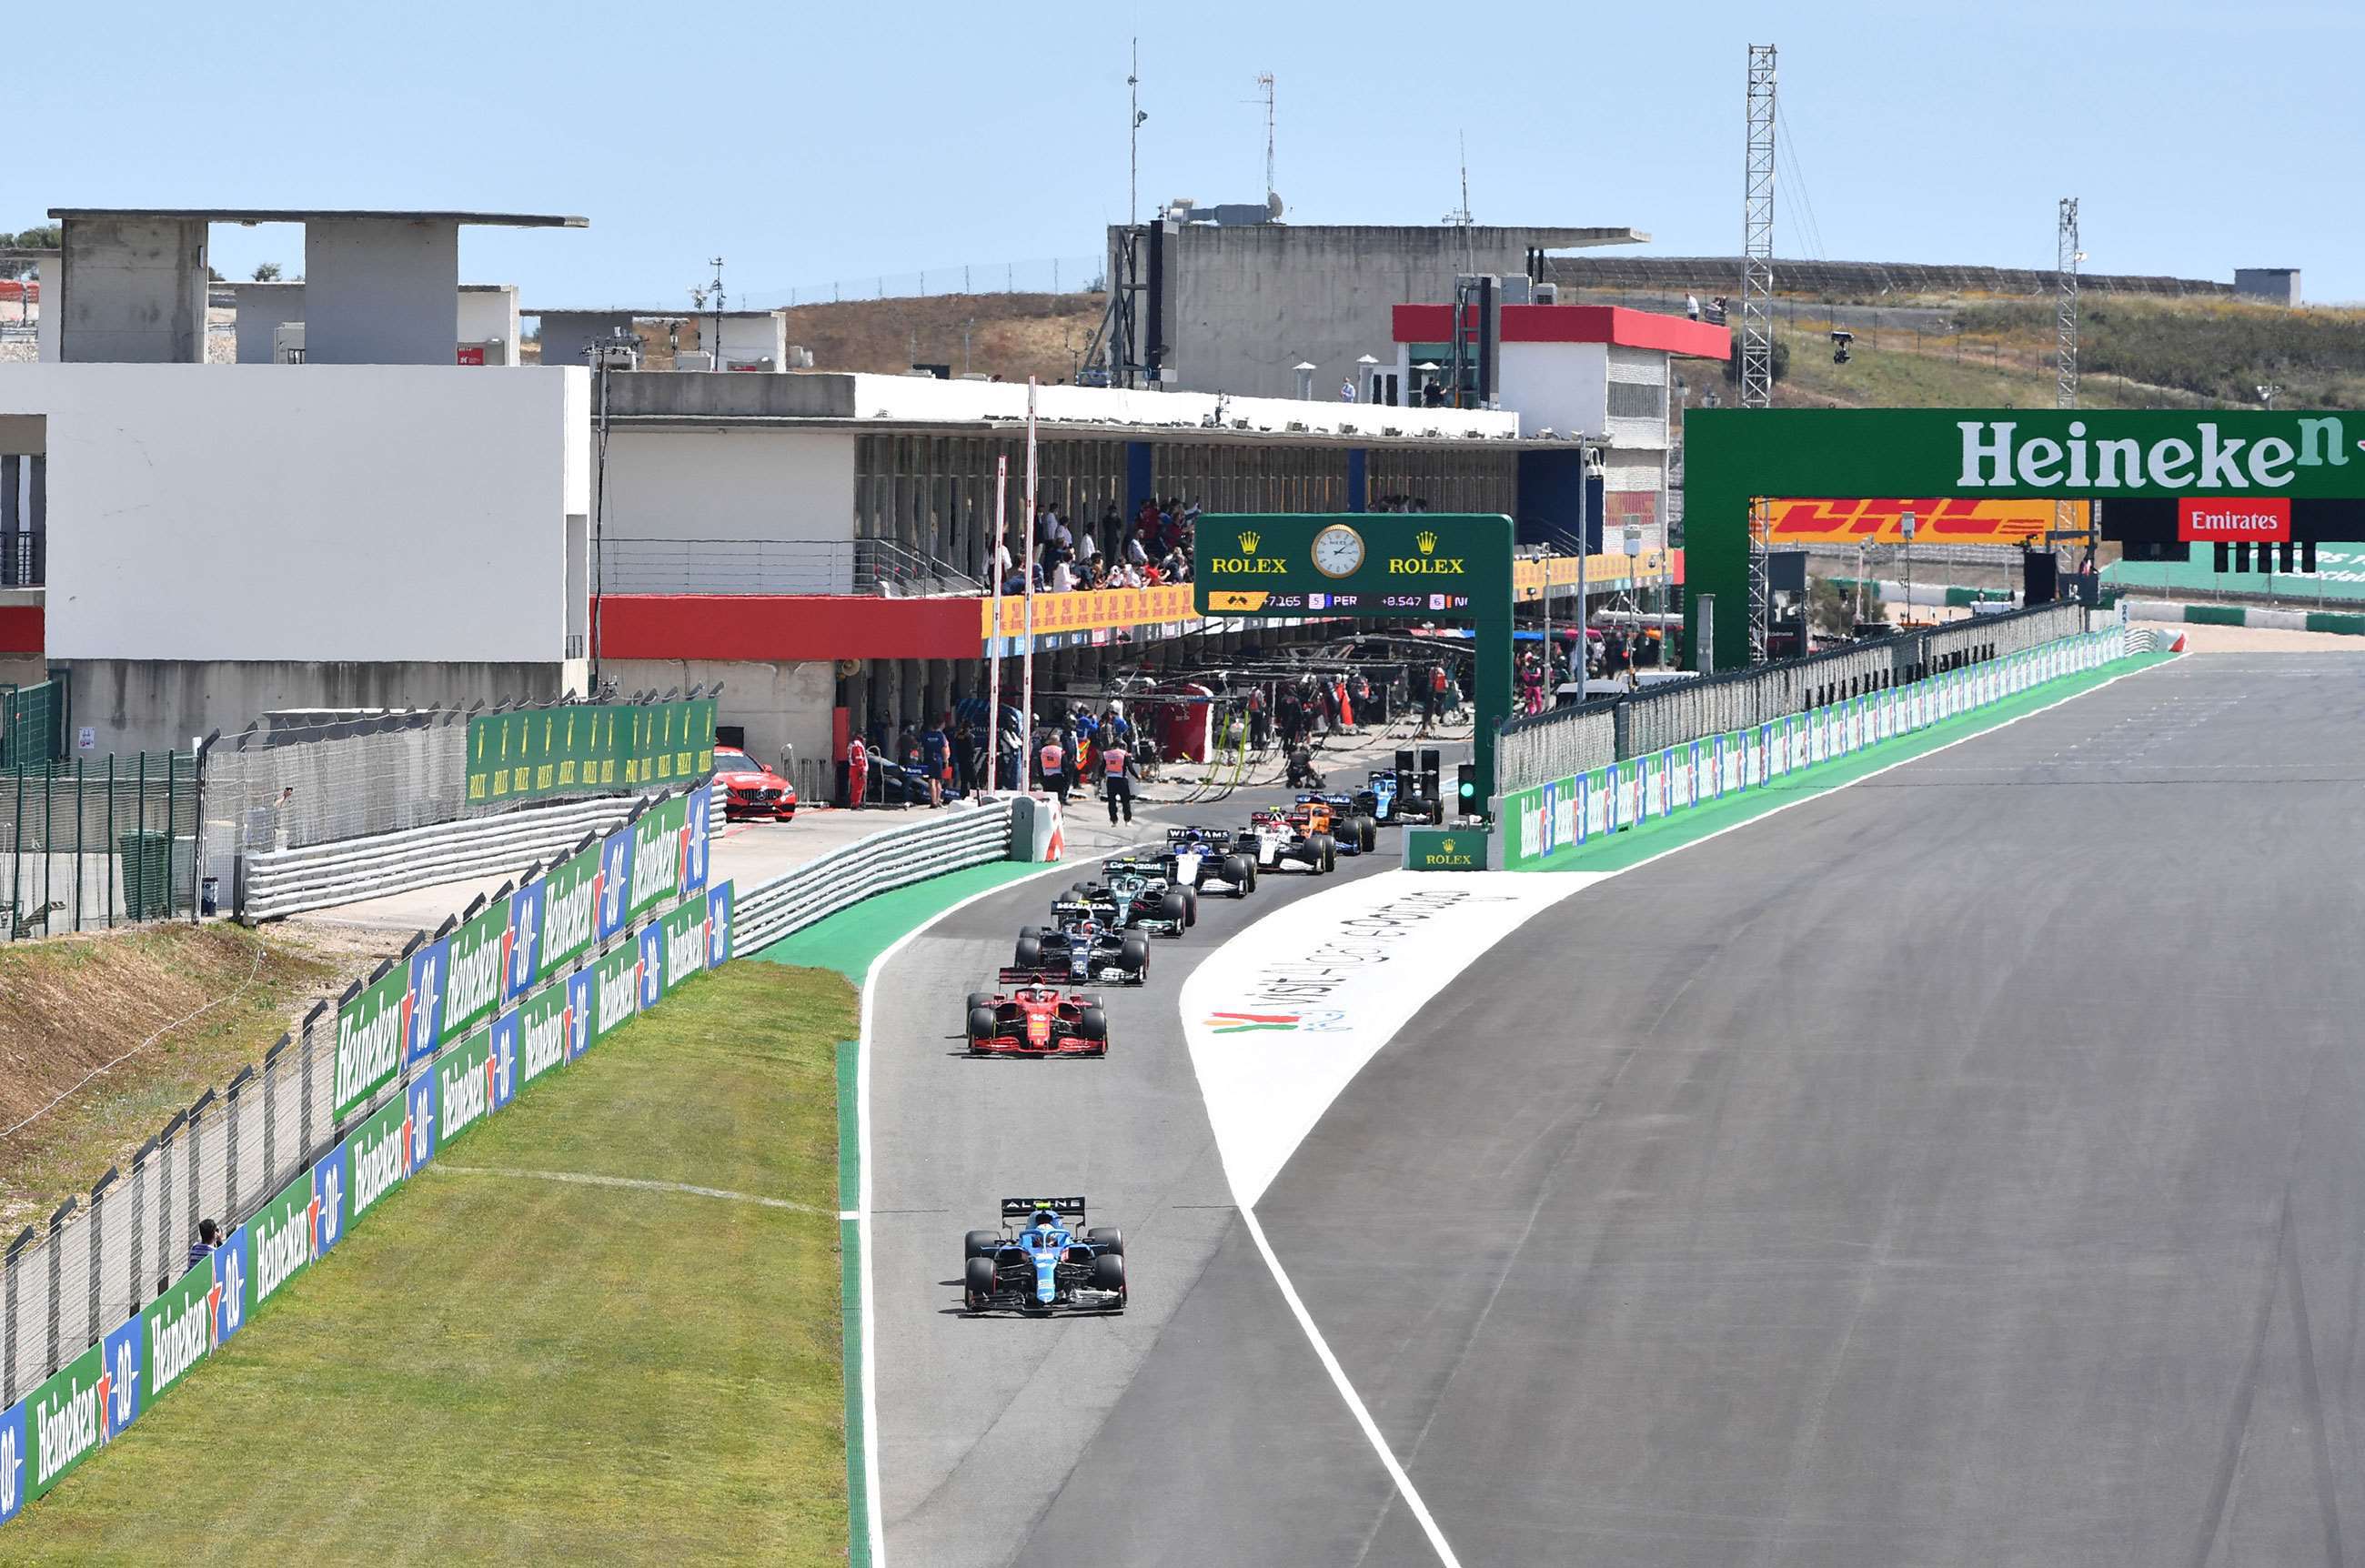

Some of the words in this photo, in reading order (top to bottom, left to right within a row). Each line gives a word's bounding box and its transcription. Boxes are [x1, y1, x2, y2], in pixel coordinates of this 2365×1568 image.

[1957, 416, 2350, 487] Heineken
[1212, 558, 1288, 574] ROLEX
[1388, 558, 1464, 574] ROLEX
[2191, 510, 2278, 530] Emirates
[1333, 596, 1358, 606] PER
[1382, 597, 1422, 607] +8.547
[1425, 854, 1472, 865] ROLEX
[540, 867, 592, 970] Heineken
[444, 924, 500, 1032] Heineken
[336, 990, 399, 1111] Heineken
[442, 1053, 486, 1141] Heineken
[354, 1121, 402, 1217] Heineken
[256, 1202, 307, 1303] Heineken
[151, 1292, 207, 1396] Heineken
[36, 1377, 96, 1485] Heineken
